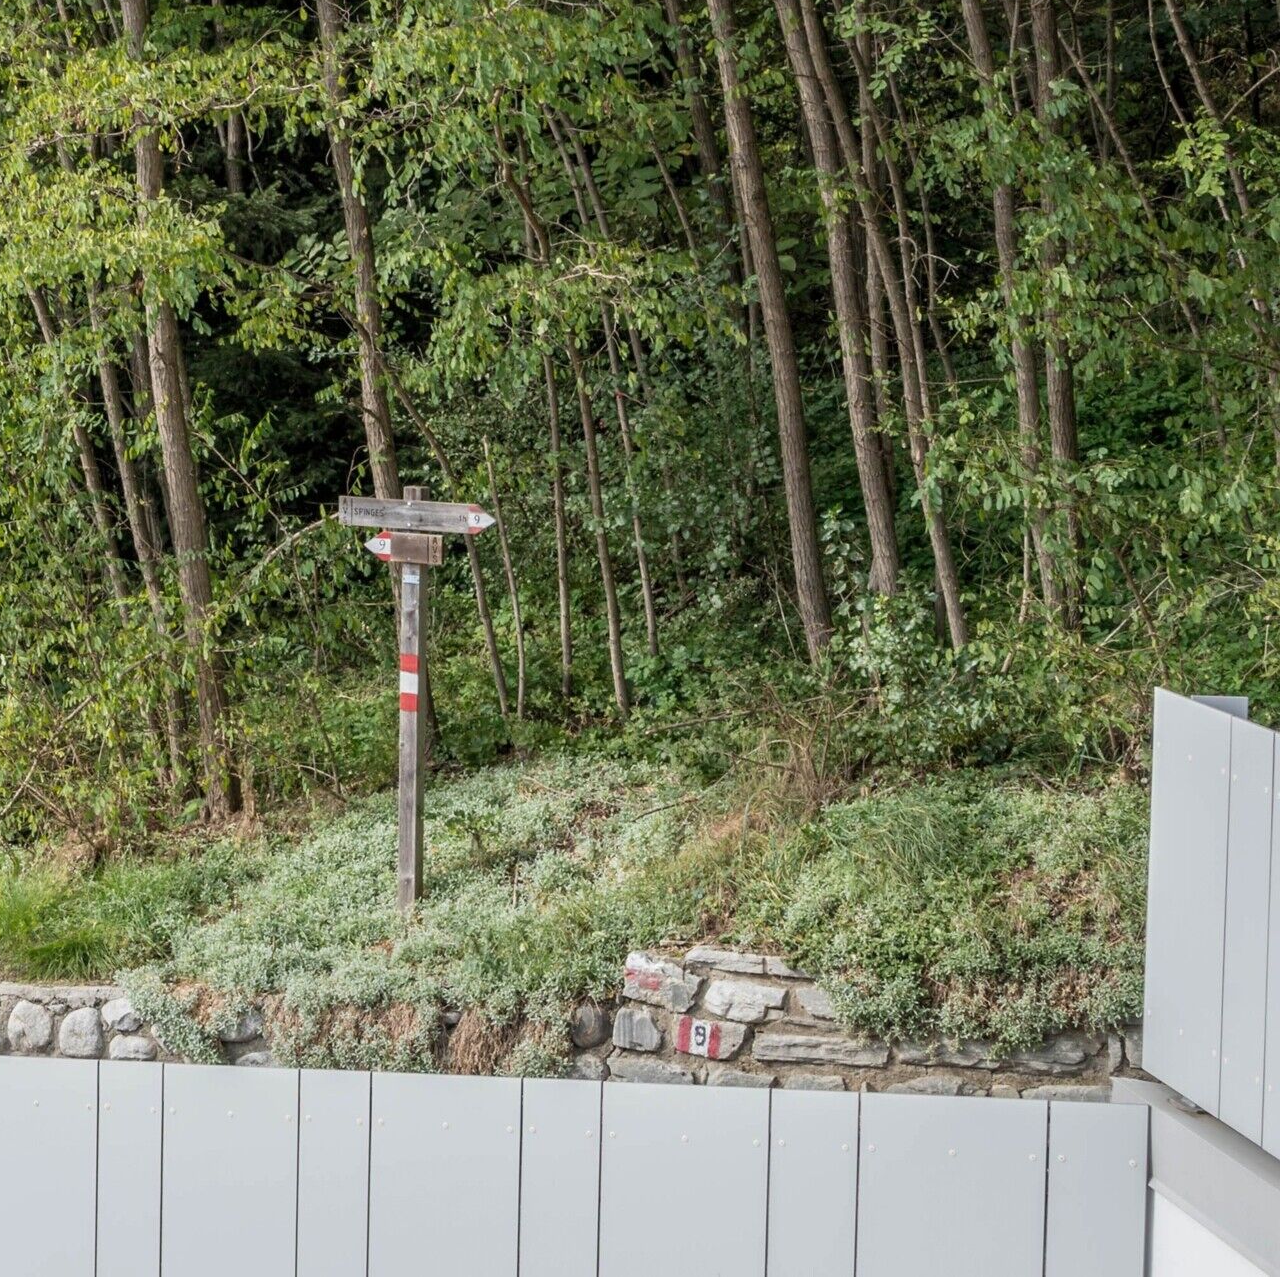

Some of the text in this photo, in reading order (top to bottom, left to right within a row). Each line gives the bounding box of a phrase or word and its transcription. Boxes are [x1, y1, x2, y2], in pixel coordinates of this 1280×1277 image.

[353, 507, 385, 517] SPINGES
[473, 514, 481, 524] 9
[379, 539, 386, 551] 9
